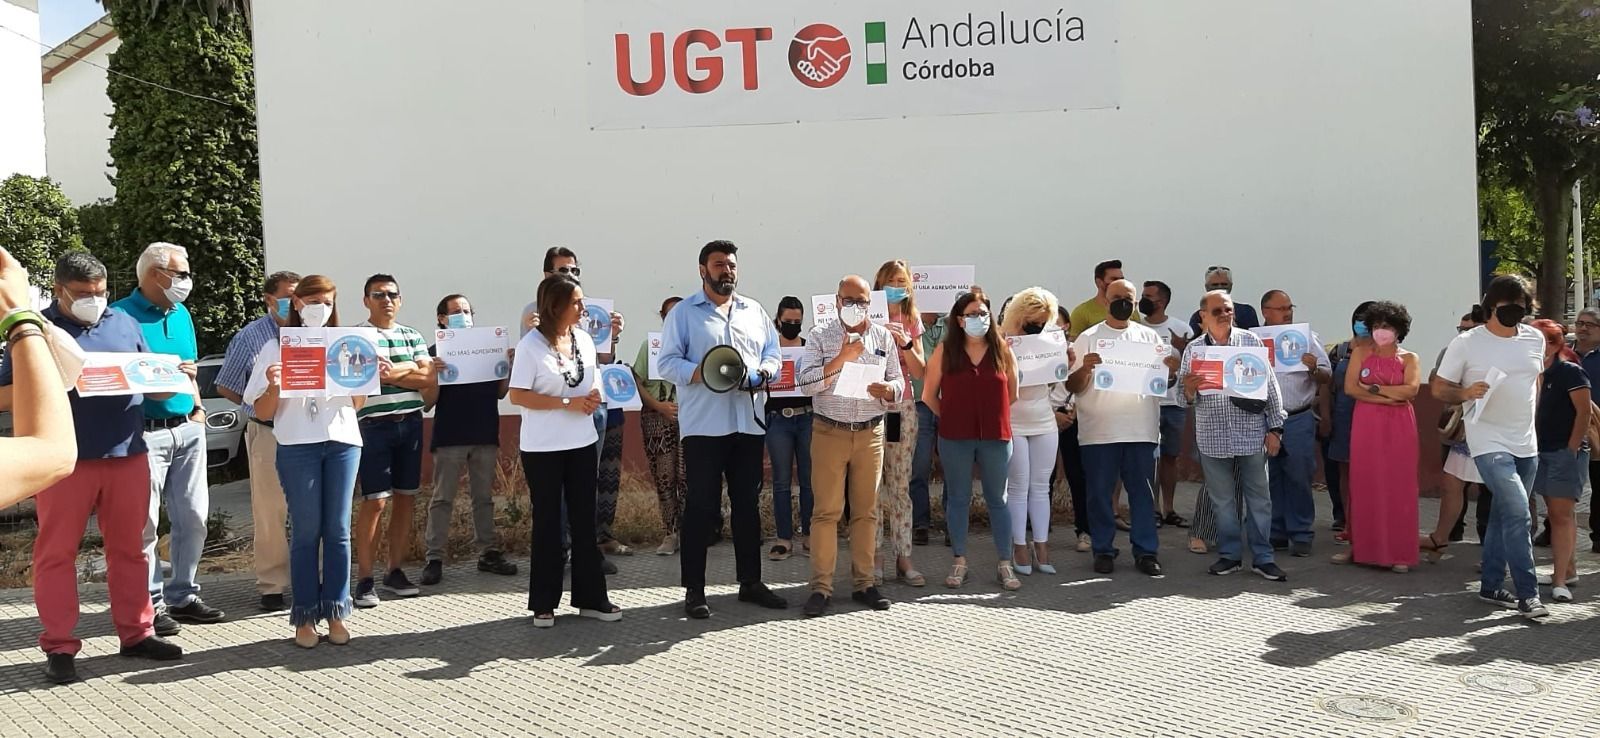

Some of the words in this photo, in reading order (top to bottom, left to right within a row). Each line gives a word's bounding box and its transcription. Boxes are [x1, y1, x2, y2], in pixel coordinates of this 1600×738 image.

[902, 9, 1085, 50] Andalucía
[615, 27, 773, 97] UGT
[902, 58, 995, 81] Córdoba
[472, 347, 503, 355] AGRESIONES
